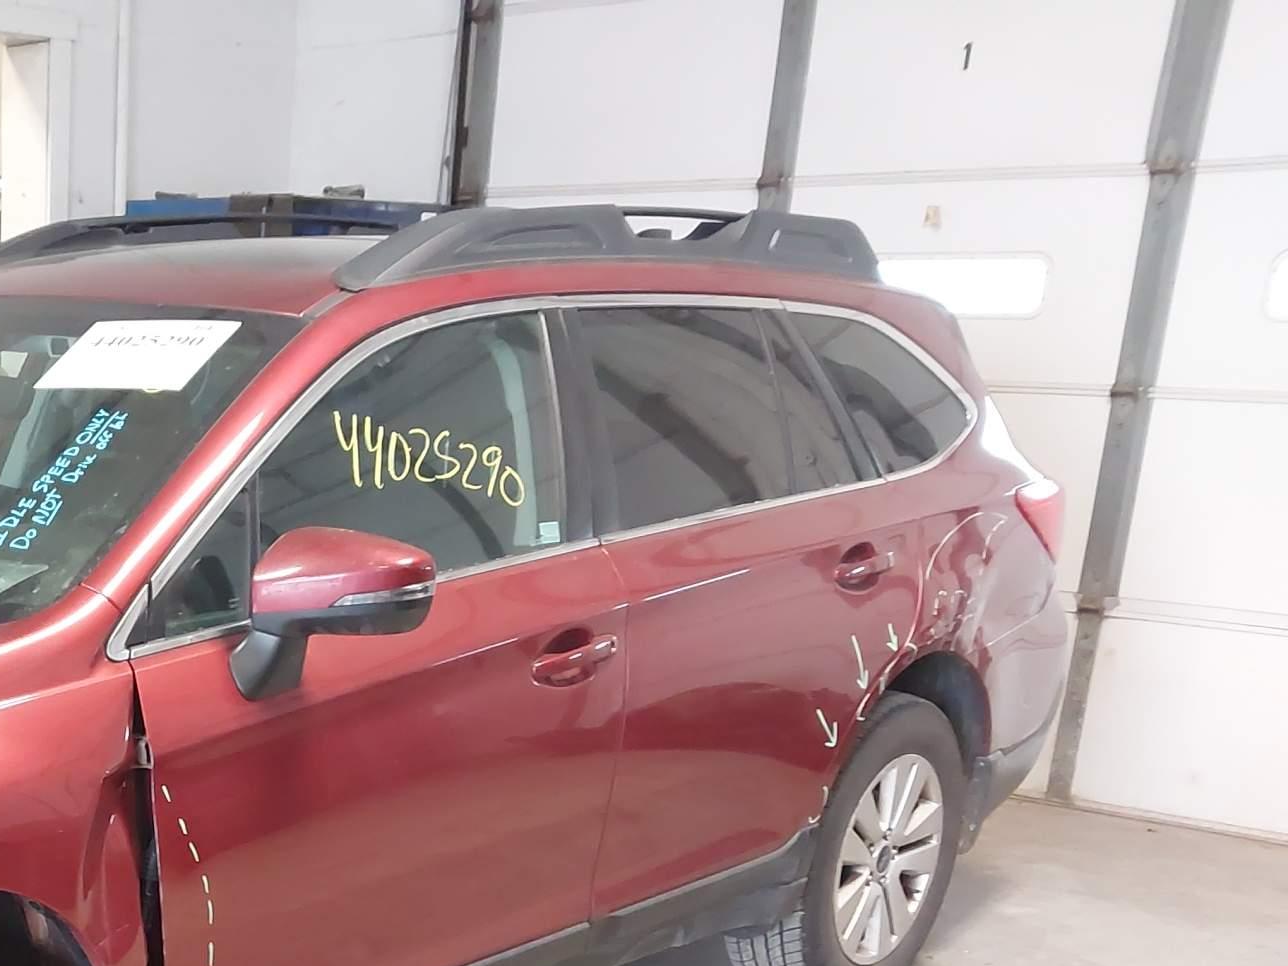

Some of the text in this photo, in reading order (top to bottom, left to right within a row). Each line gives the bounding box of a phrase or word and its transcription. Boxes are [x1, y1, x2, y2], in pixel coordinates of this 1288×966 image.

[31, 446, 80, 493] SPEED
[75, 408, 110, 445] ONLY
[333, 410, 526, 507] 44025290
[9, 528, 37, 550] Do
[31, 488, 63, 526] NOT
